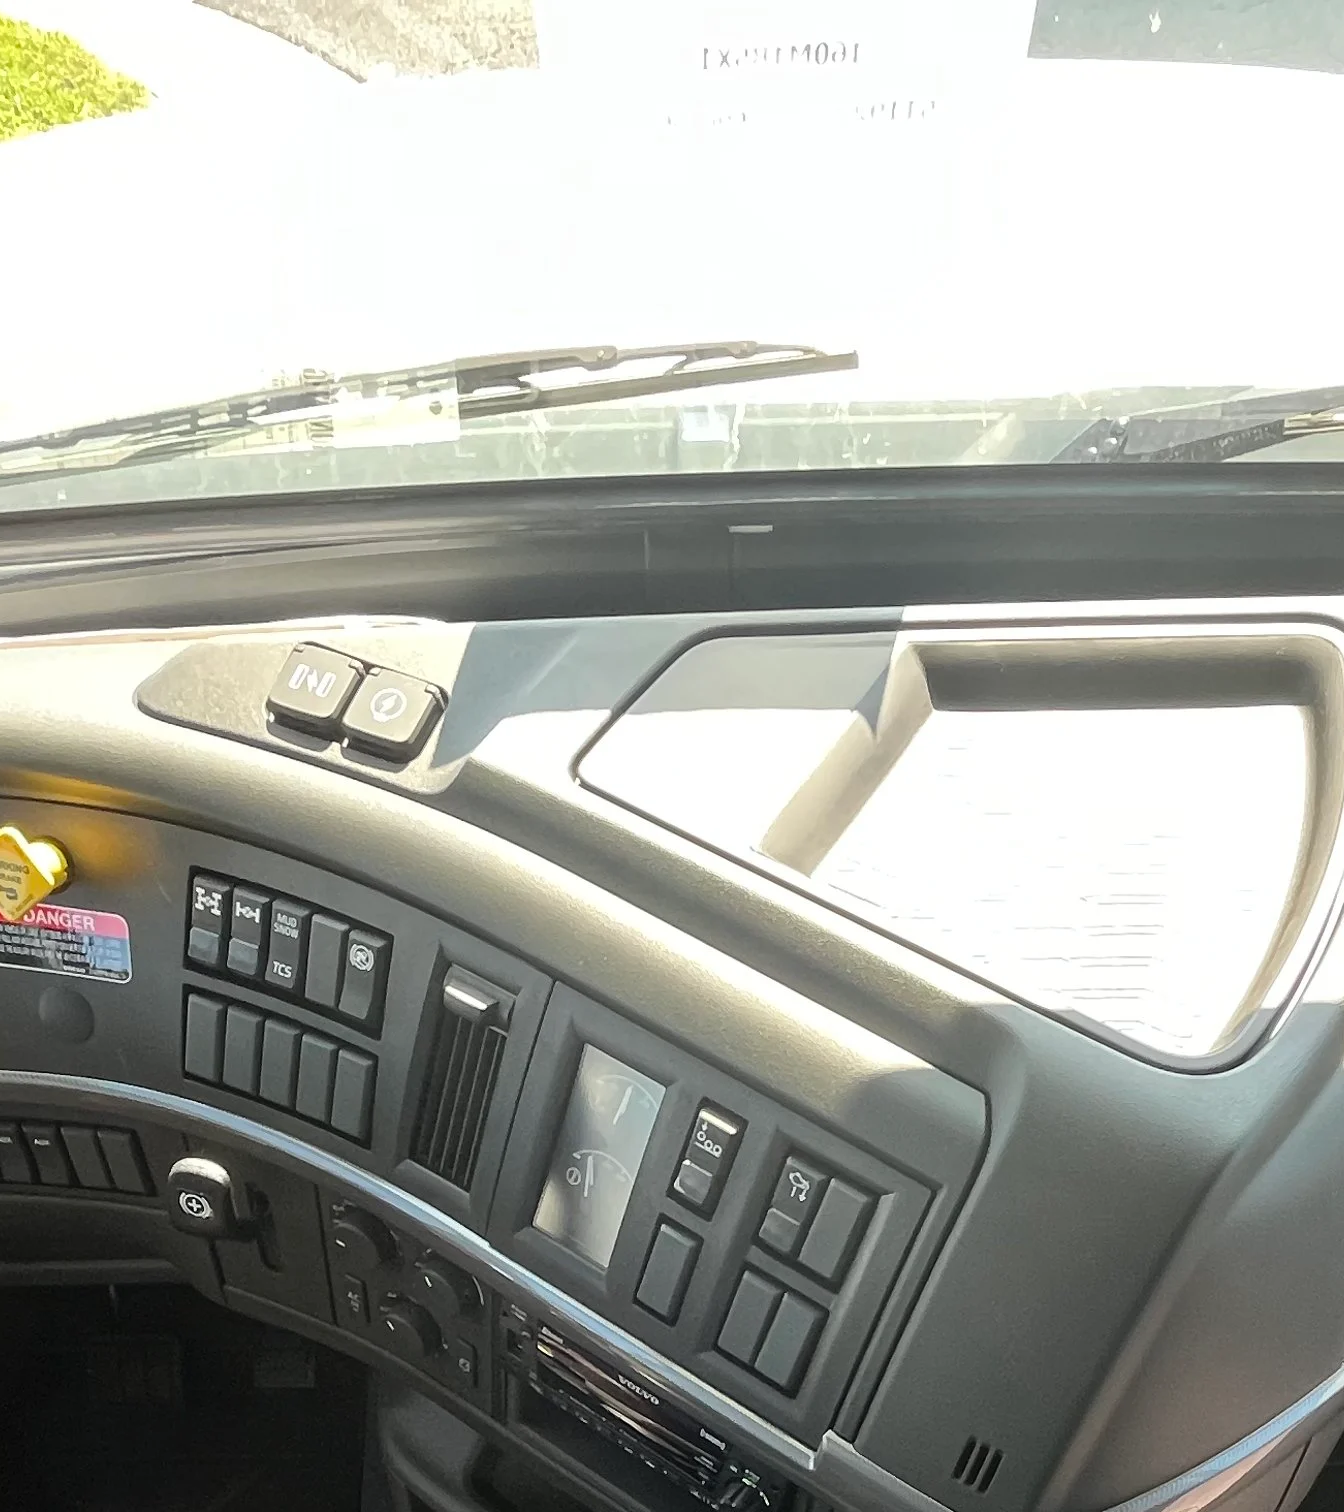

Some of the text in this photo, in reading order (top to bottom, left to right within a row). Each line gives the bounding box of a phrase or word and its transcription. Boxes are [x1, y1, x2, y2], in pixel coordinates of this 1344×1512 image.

[276, 912, 297, 928] MUD
[273, 921, 299, 939] SNOW
[272, 960, 292, 978] TCS
[618, 1374, 659, 1405] VOLVO
